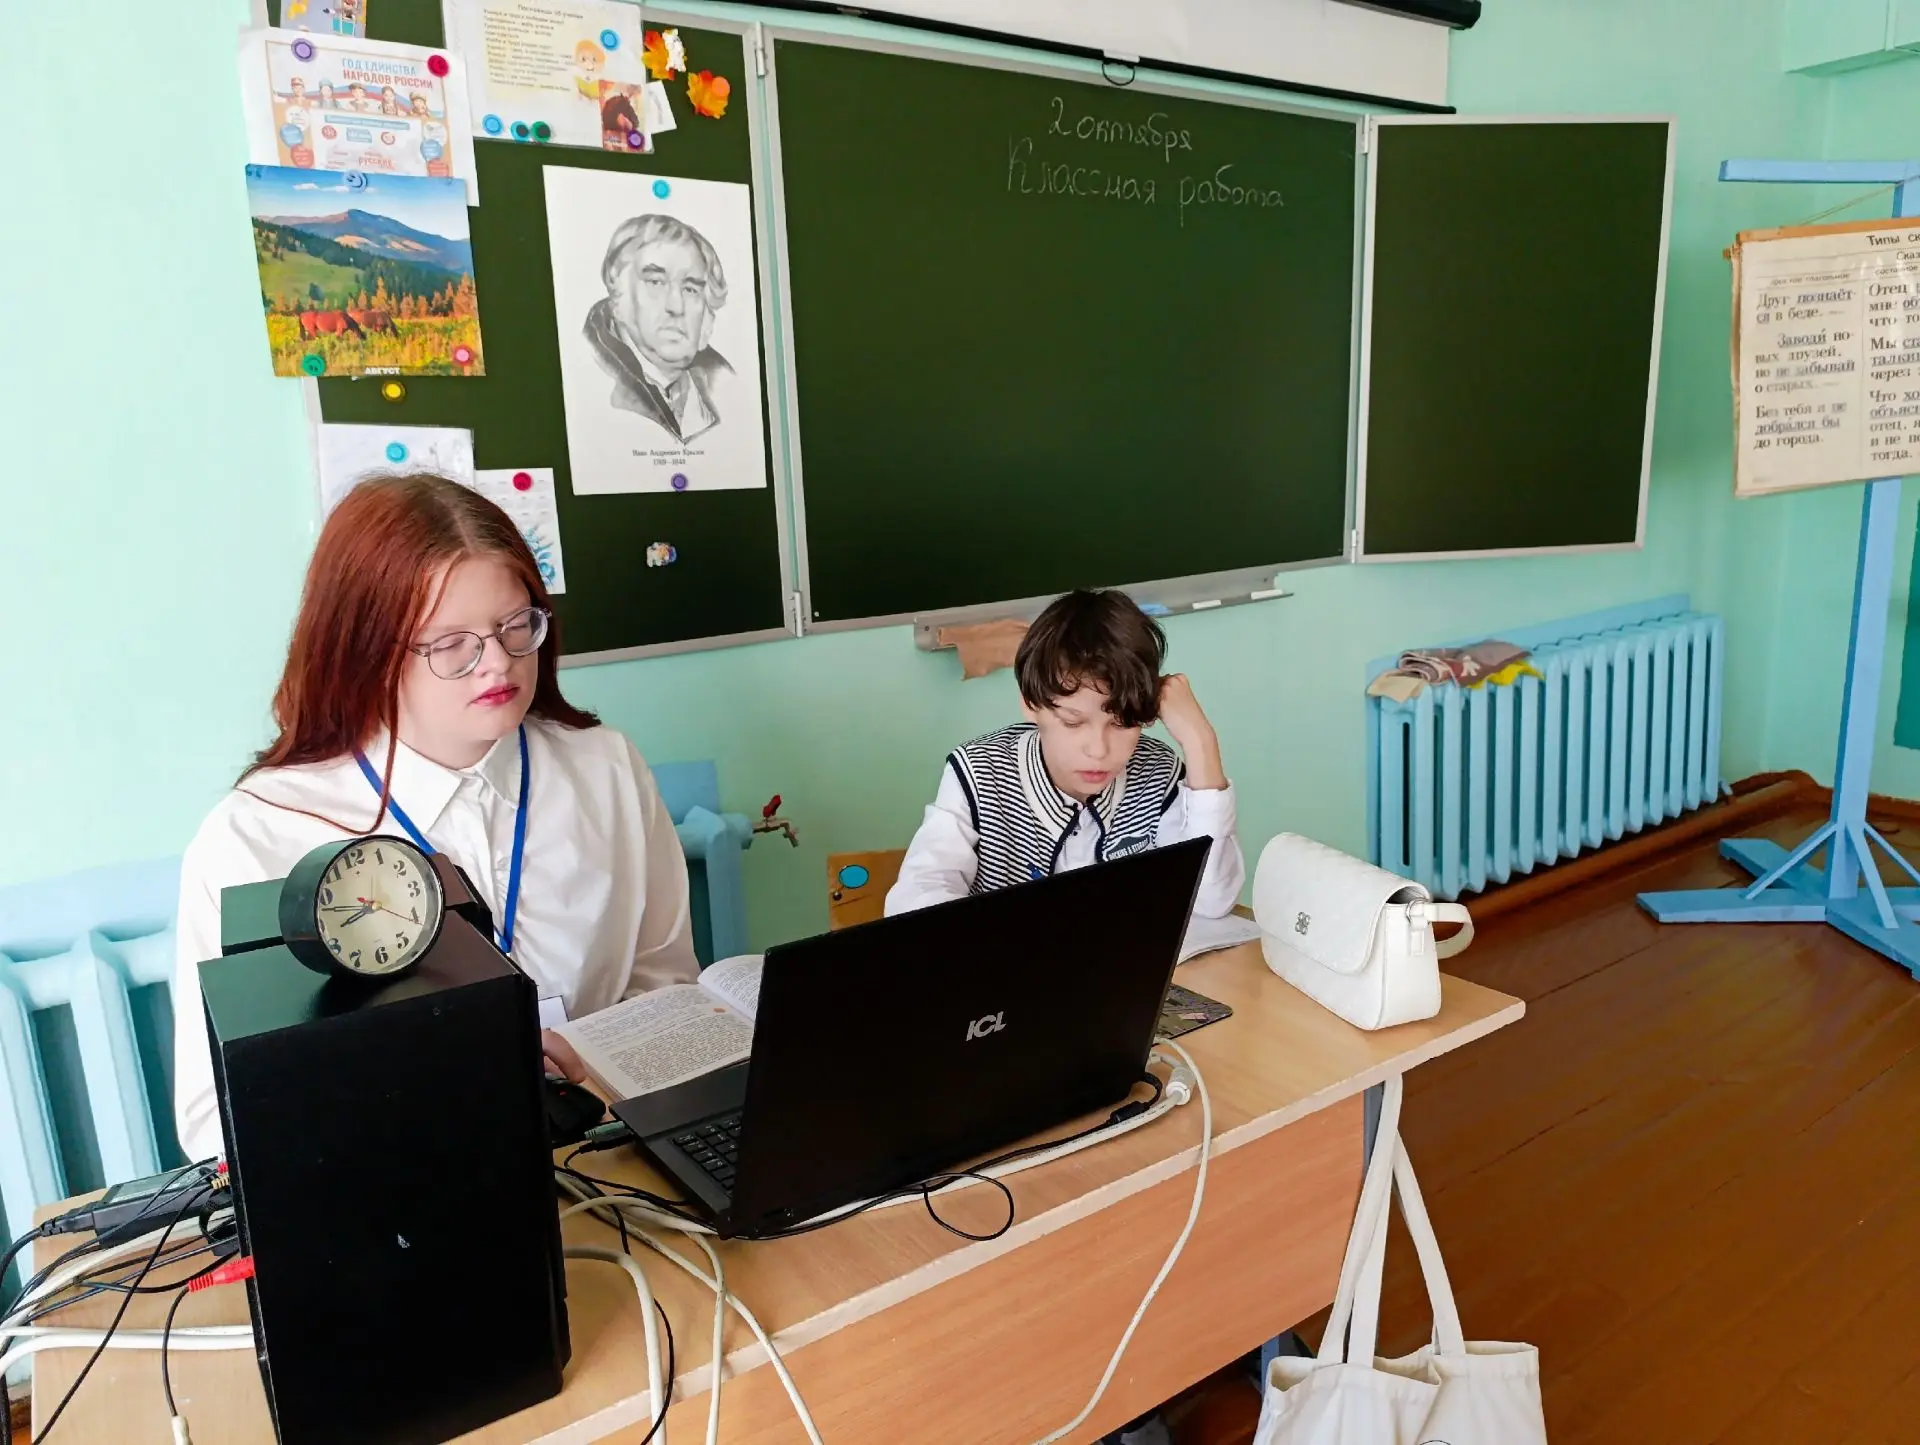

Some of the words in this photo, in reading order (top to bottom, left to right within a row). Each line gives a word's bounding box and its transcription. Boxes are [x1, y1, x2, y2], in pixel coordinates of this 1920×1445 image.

[342, 58, 363, 71] ГОД
[365, 61, 417, 76] ЕДИНСТВА
[343, 69, 392, 85] НАРОДОВ
[394, 76, 433, 89] РОССИИ
[1049, 96, 1071, 136] 2
[1076, 112, 1192, 163] октября
[1008, 136, 1156, 205] Классная
[1179, 164, 1284, 227] работа
[1866, 234, 1900, 246] Типы
[1869, 282, 1908, 297] Отец
[1757, 292, 1790, 310] Друг
[1776, 311, 1783, 321] в
[1869, 316, 1897, 327] что
[1871, 336, 1897, 350] Мы
[1755, 352, 1779, 364] вых
[365, 366, 401, 375] АВГУСТ
[1870, 367, 1911, 382] через
[1755, 384, 1763, 393] о
[1869, 389, 1897, 402] Что
[1783, 403, 1812, 416] тебя
[1822, 415, 1840, 429] бы
[1753, 438, 1770, 450] до
[1870, 437, 1879, 447] и
[1885, 435, 1901, 446] не
[346, 849, 366, 870] 12
[375, 848, 384, 865] 1
[326, 866, 342, 884] 11
[393, 860, 407, 878] 2
[407, 880, 421, 898] 3
[410, 906, 420, 925] 4
[328, 938, 342, 956] 8
[395, 931, 410, 950] 5
[349, 949, 362, 968] 7
[375, 946, 389, 964] 6
[966, 1011, 1006, 1041] ICL
